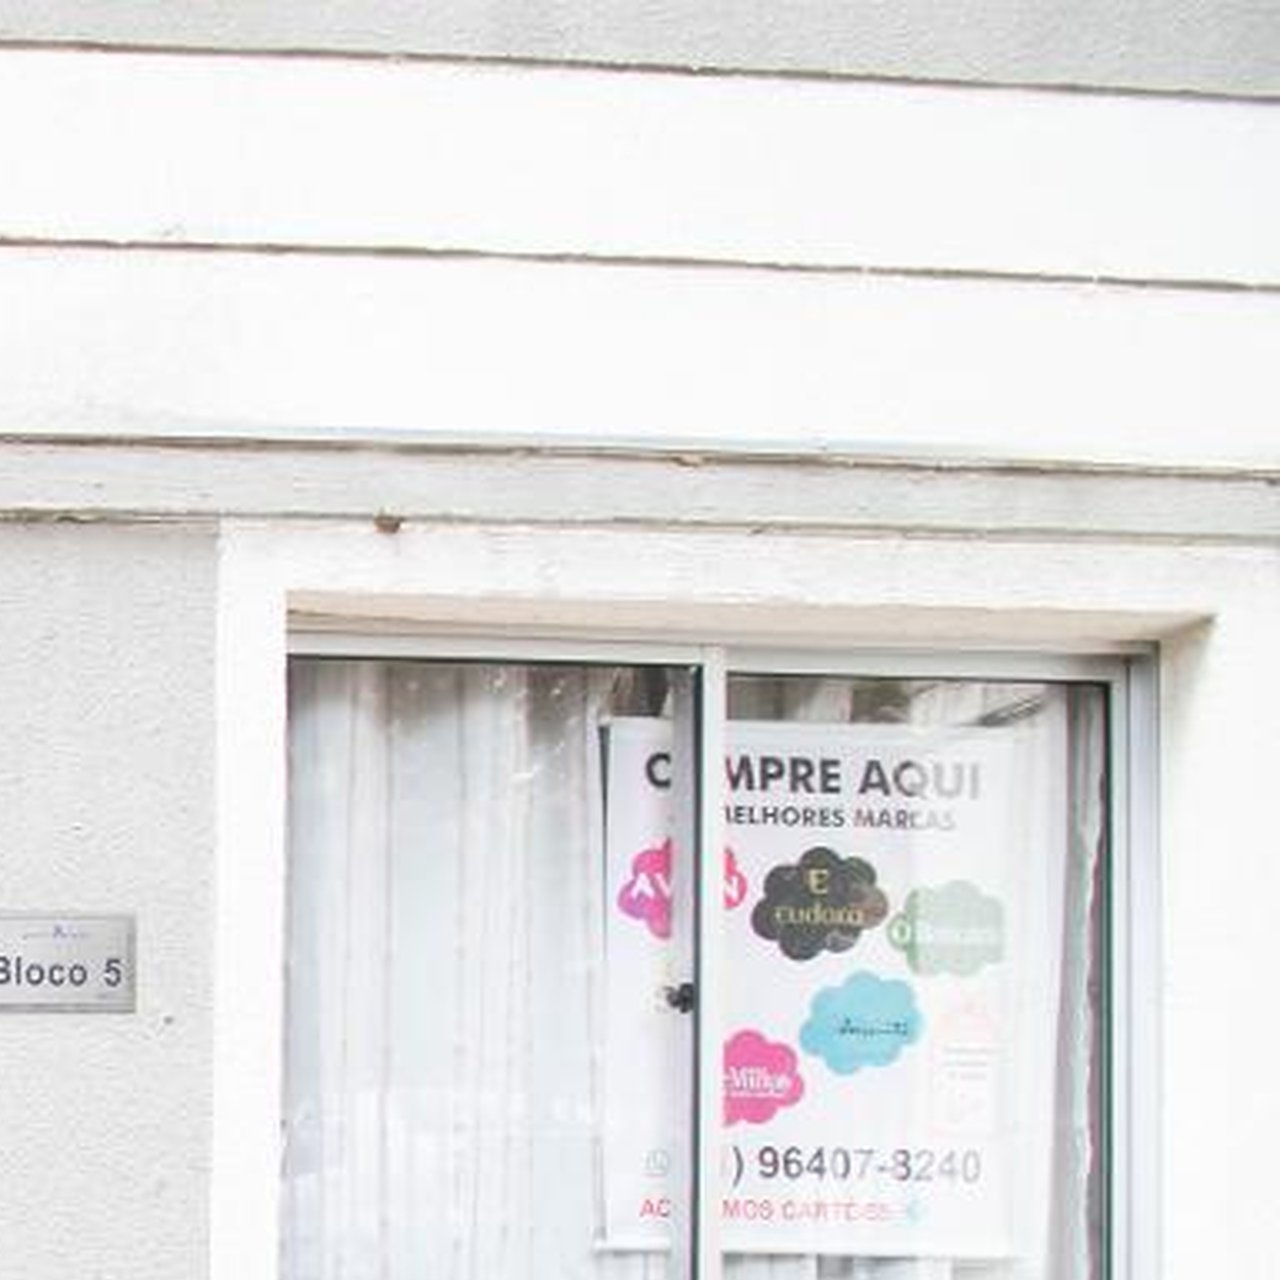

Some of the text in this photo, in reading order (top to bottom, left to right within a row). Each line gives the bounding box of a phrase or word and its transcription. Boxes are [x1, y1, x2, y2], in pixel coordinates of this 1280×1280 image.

[646, 754, 981, 799] CMPRE AQUI
[631, 872, 738, 902] AVN
[103, 958, 122, 986] 5
[758, 1147, 981, 1183] 96407-8240
